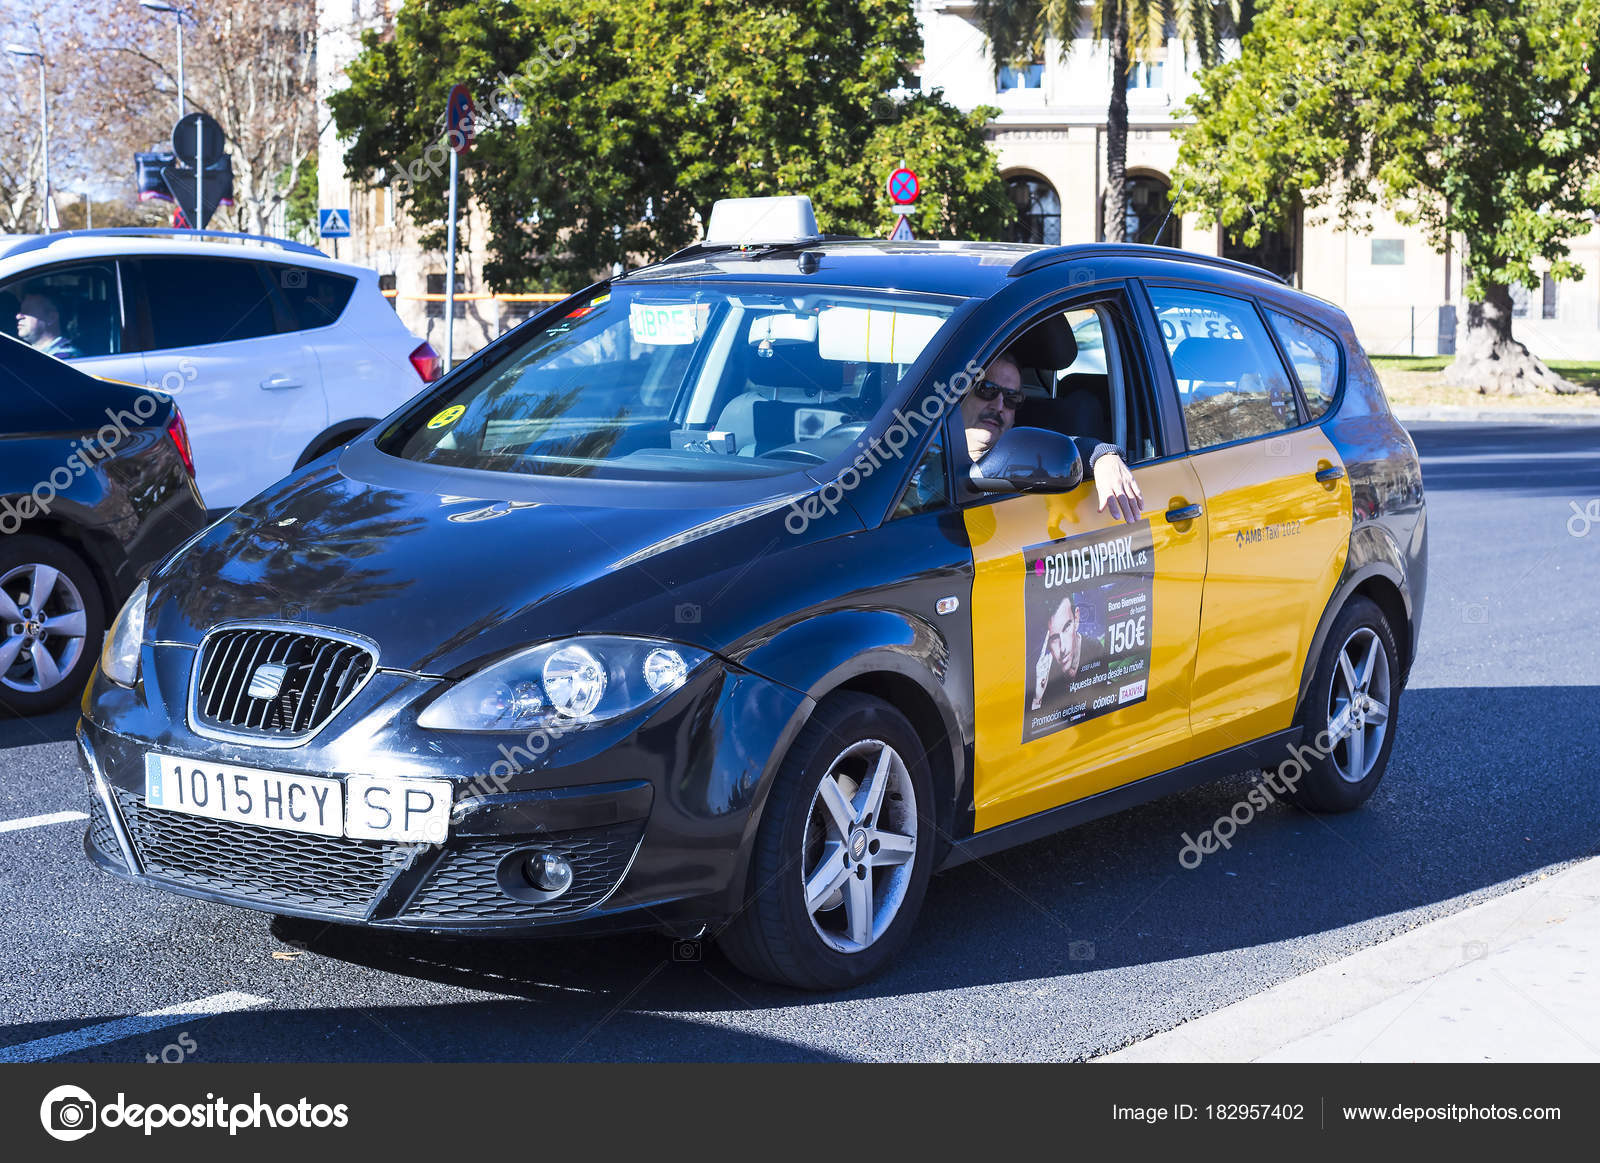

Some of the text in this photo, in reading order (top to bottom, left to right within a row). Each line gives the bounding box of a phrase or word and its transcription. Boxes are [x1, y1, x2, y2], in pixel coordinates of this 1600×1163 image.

[635, 309, 687, 337] LIBRE
[1245, 520, 1301, 544] AMB Taxi 1022
[1044, 536, 1148, 589] GOLDENPARK.es
[1108, 593, 1146, 612] Bono Bienvenida
[1108, 615, 1146, 655] 150€
[1092, 672, 1107, 685] ahora
[1107, 668, 1122, 680] desde
[1122, 665, 1129, 674] tu
[151, 785, 160, 797] E
[174, 765, 329, 826] 1015 HCY
[364, 786, 435, 831] SP
